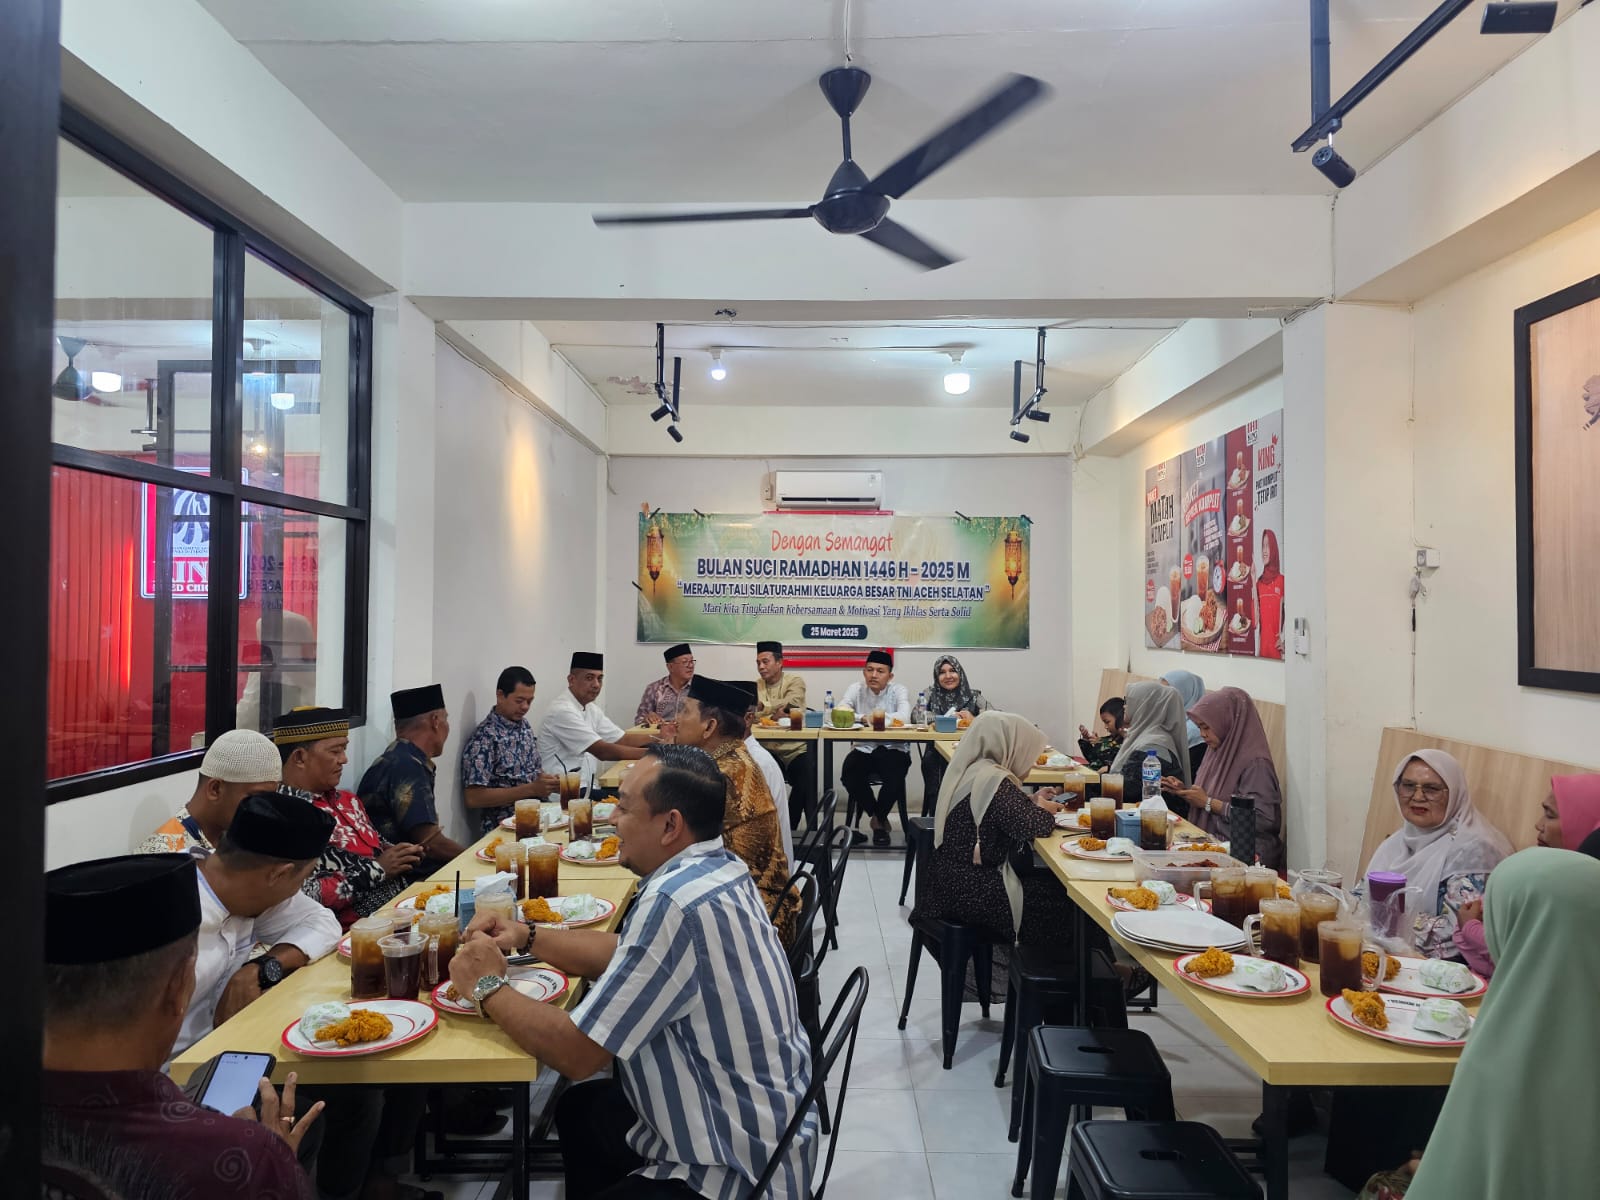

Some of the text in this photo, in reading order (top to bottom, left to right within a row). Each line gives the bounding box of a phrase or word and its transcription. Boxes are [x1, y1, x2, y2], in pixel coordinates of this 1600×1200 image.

[1258, 445, 1275, 471] KING
[1150, 495, 1174, 526] MATAH
[771, 530, 893, 557] Dengan Semangat
[697, 558, 742, 576] BULAN
[745, 559, 777, 576] SUCI
[780, 560, 861, 577] RAMADHAN
[864, 560, 896, 578] 1446
[898, 561, 909, 578] H
[921, 561, 954, 578] 2025
[957, 562, 970, 578] M
[728, 583, 748, 595] TALI
[750, 584, 812, 596] SILATURAHMI
[814, 585, 863, 597] KELUARGA
[865, 585, 895, 598] BESAR
[897, 586, 911, 598] TNI
[913, 586, 939, 598] ACEH
[702, 602, 971, 620] Mari Kita Tingkatkan Kebersamaan & Motivasi Yang Ikhlas Serta Solid
[810, 626, 859, 637] 25 Maret 2025
